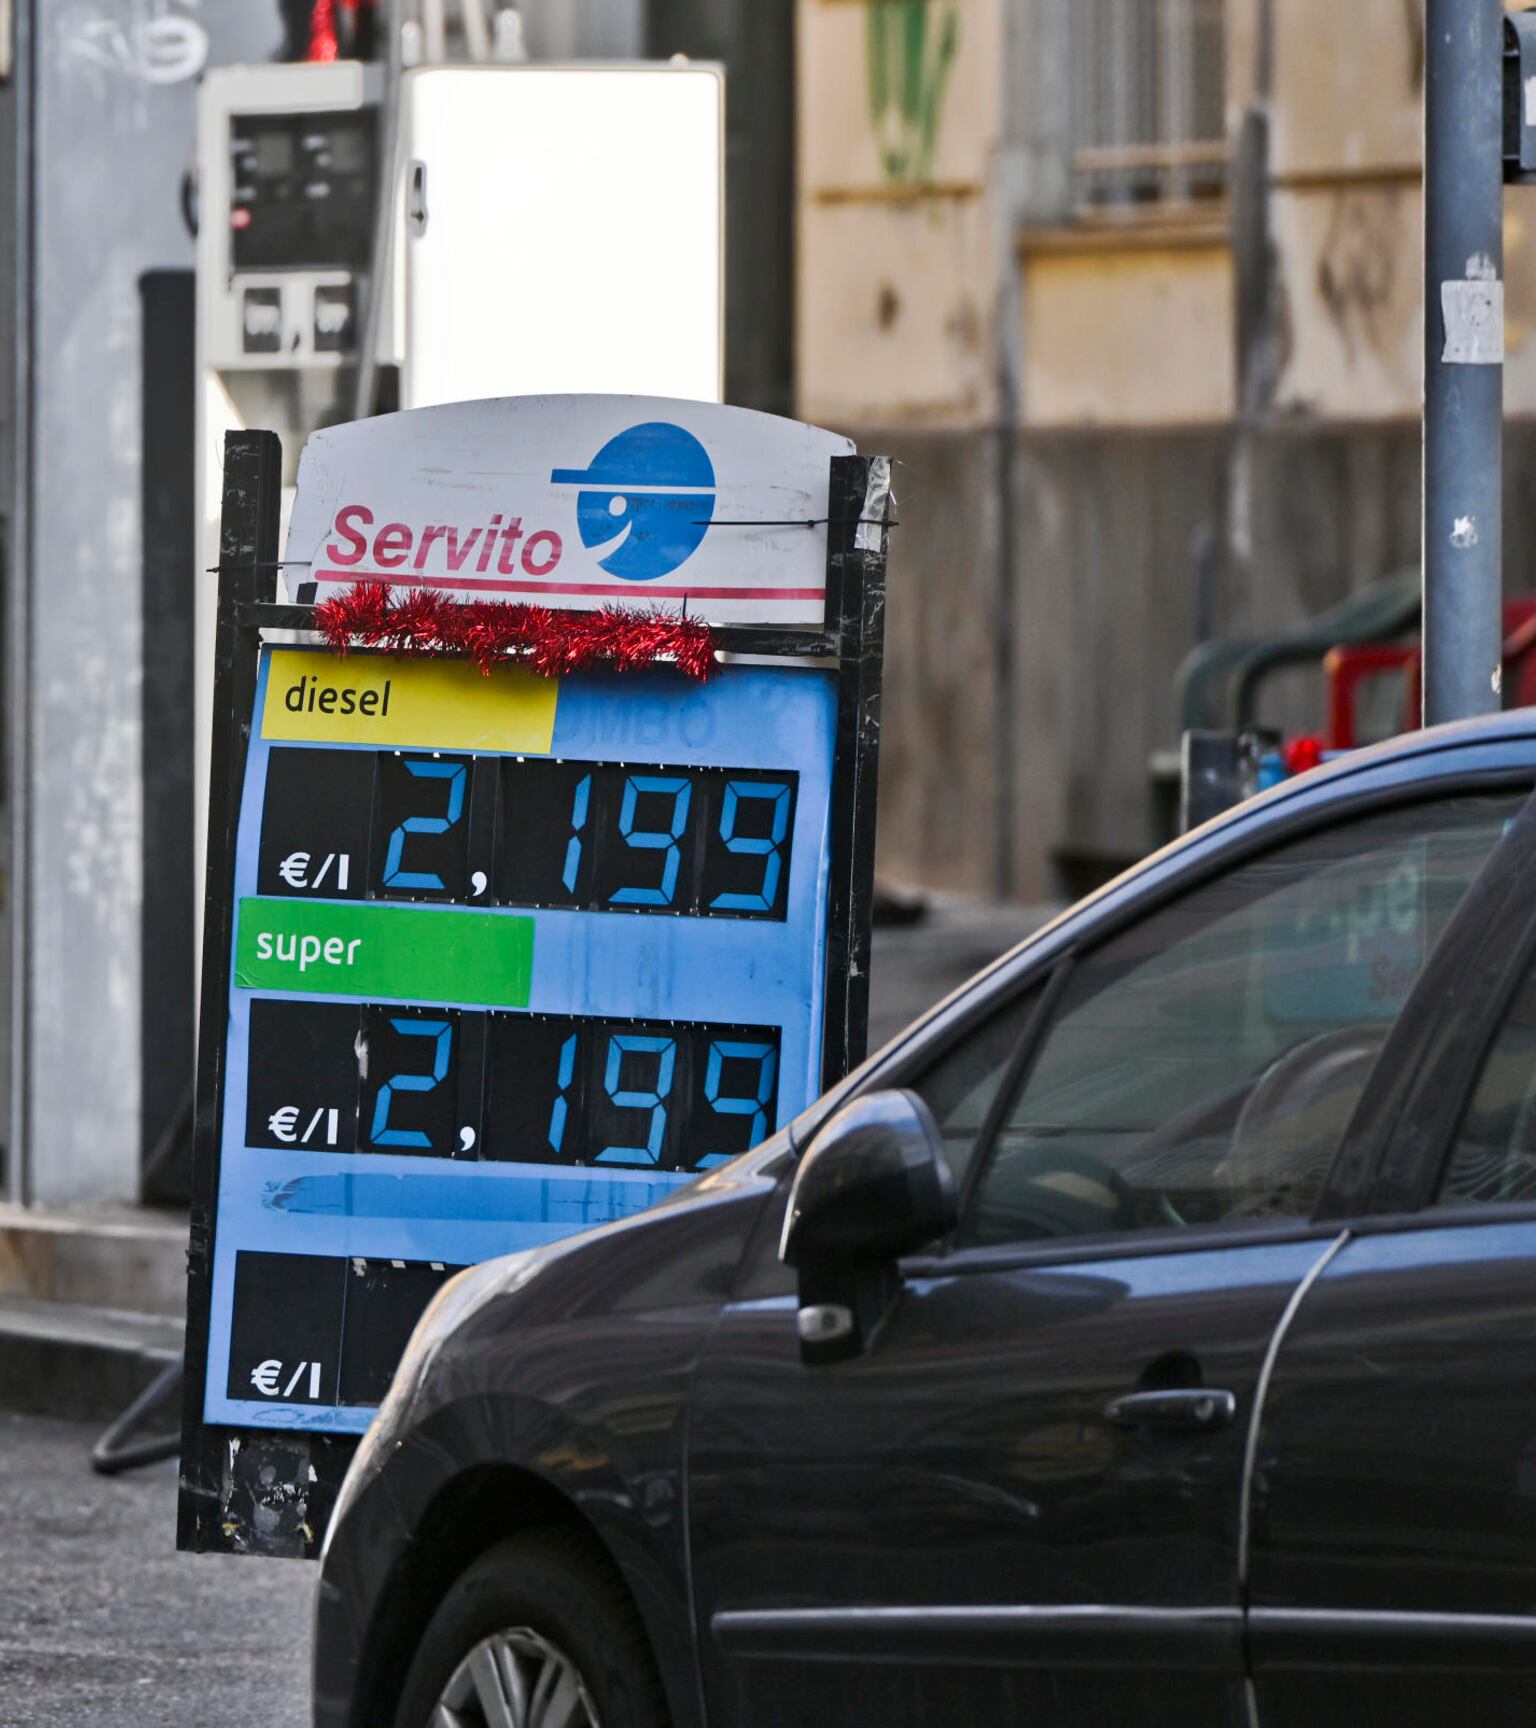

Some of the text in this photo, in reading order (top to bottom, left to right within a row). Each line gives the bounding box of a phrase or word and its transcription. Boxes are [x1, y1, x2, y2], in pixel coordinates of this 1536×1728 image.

[326, 504, 564, 576] Servito
[284, 676, 391, 717] diesel
[382, 760, 792, 912] 2,199
[256, 931, 362, 972] super
[370, 1018, 778, 1166] 2,199
